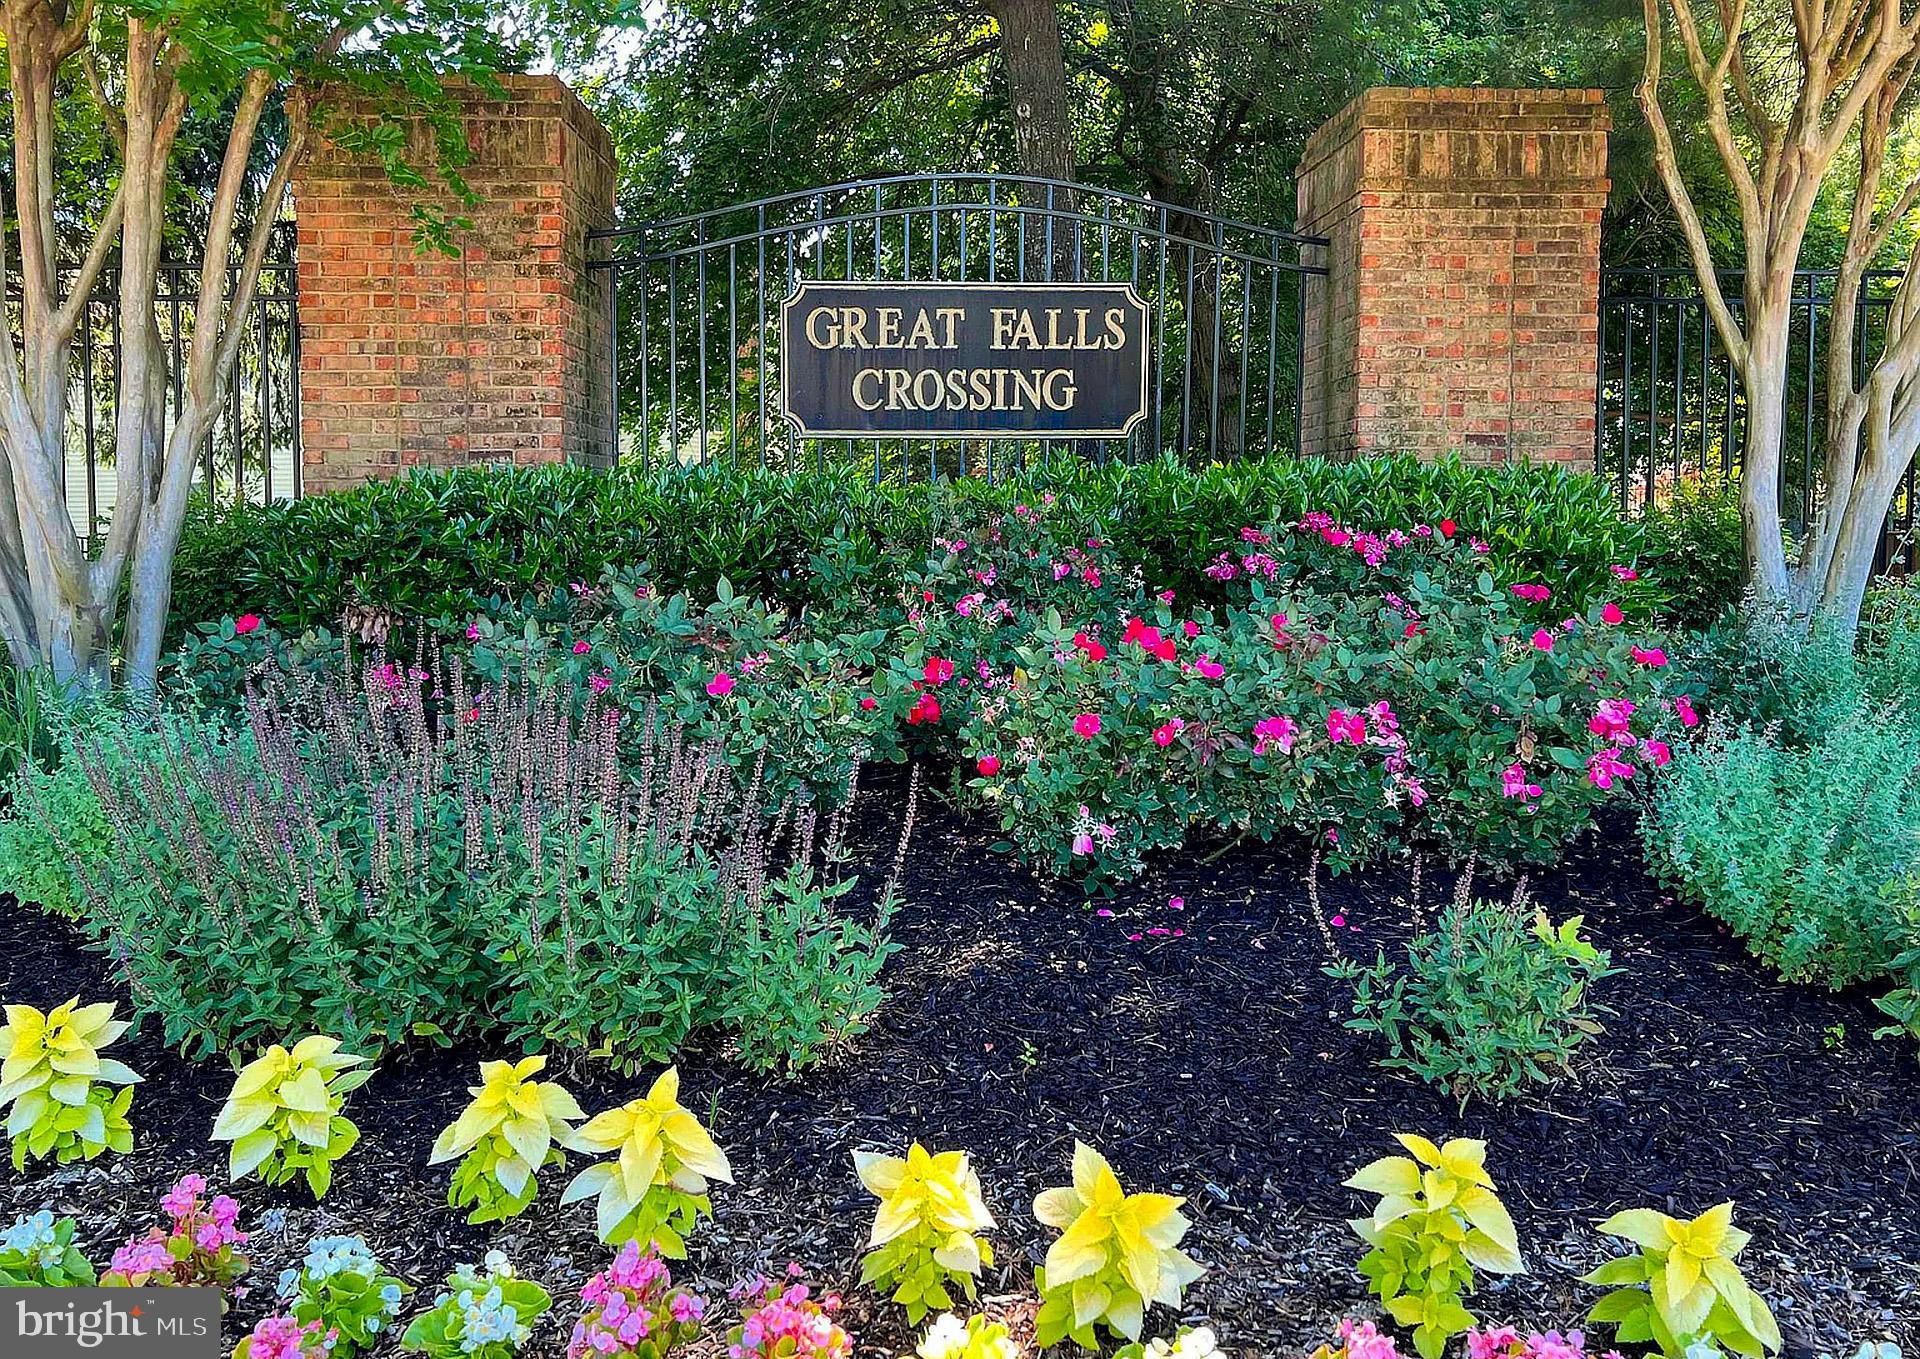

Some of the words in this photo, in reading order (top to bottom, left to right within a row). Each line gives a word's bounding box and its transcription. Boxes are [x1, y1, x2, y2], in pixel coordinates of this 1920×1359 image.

[805, 306, 965, 350] GREAT
[990, 307, 1126, 350] FALLS
[852, 367, 1078, 411] CROSSING
